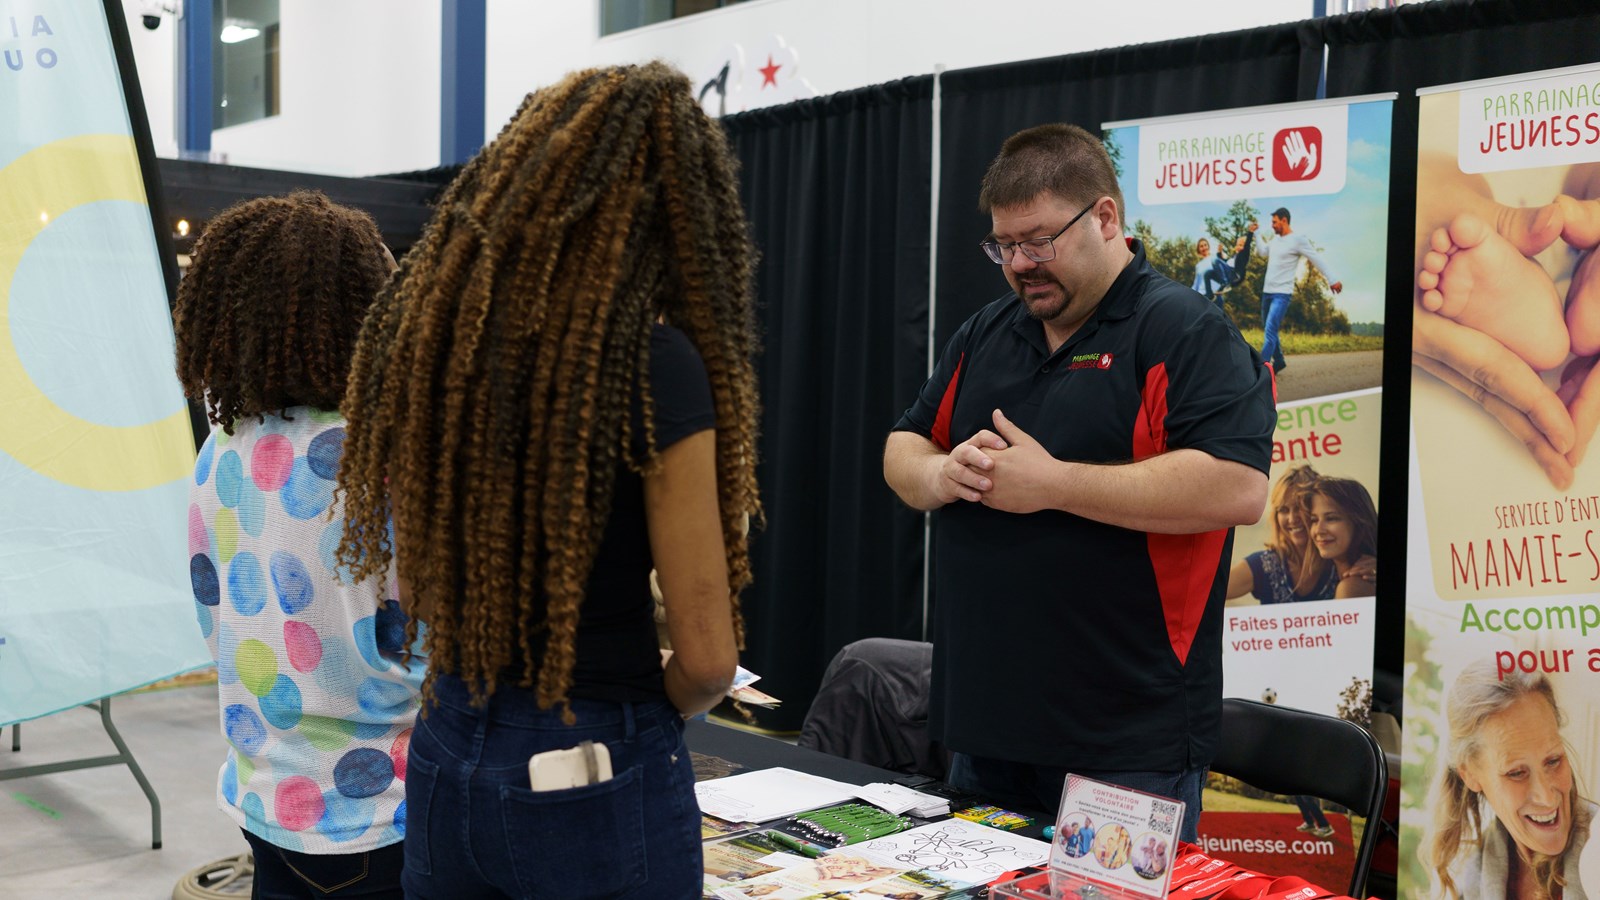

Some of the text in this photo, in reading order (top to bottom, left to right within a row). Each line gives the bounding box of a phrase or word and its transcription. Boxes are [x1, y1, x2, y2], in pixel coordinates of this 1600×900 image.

[1158, 131, 1265, 161] PARRAINAGE
[1155, 155, 1265, 189] JEUNESSE
[1277, 399, 1358, 431] ence
[1271, 431, 1342, 463] ante
[1495, 502, 1550, 529] SERVICE
[1450, 530, 1600, 591] MAMIE-S
[1229, 611, 1359, 632] Faites parrainer
[1460, 603, 1600, 637] Accomp
[1231, 633, 1333, 652] votre enfant
[1495, 649, 1574, 681] pour
[1092, 788, 1140, 805] CONTRIBUTION
[1095, 796, 1135, 811] VOLONTAIRE
